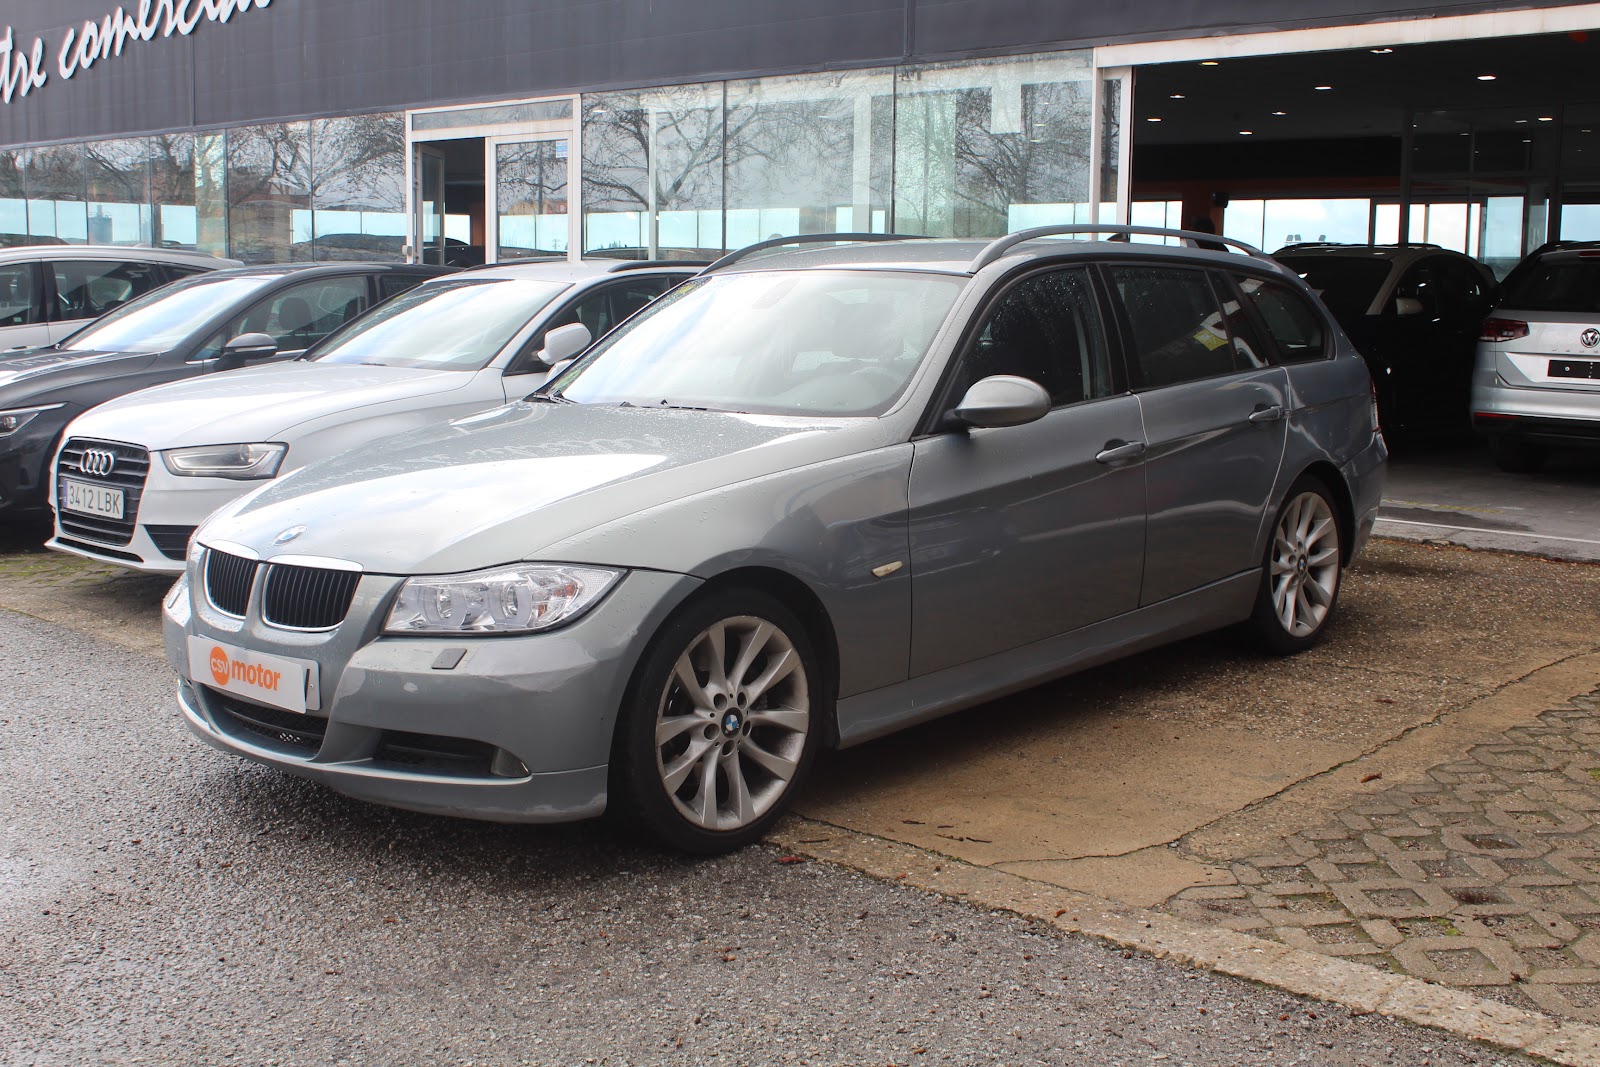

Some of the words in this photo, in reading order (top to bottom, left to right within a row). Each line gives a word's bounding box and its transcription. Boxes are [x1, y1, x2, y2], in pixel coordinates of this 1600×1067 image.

[58, 0, 270, 80] comerc
[69, 485, 94, 509] 3412
[97, 491, 120, 514] LBK
[231, 660, 281, 691] motor
